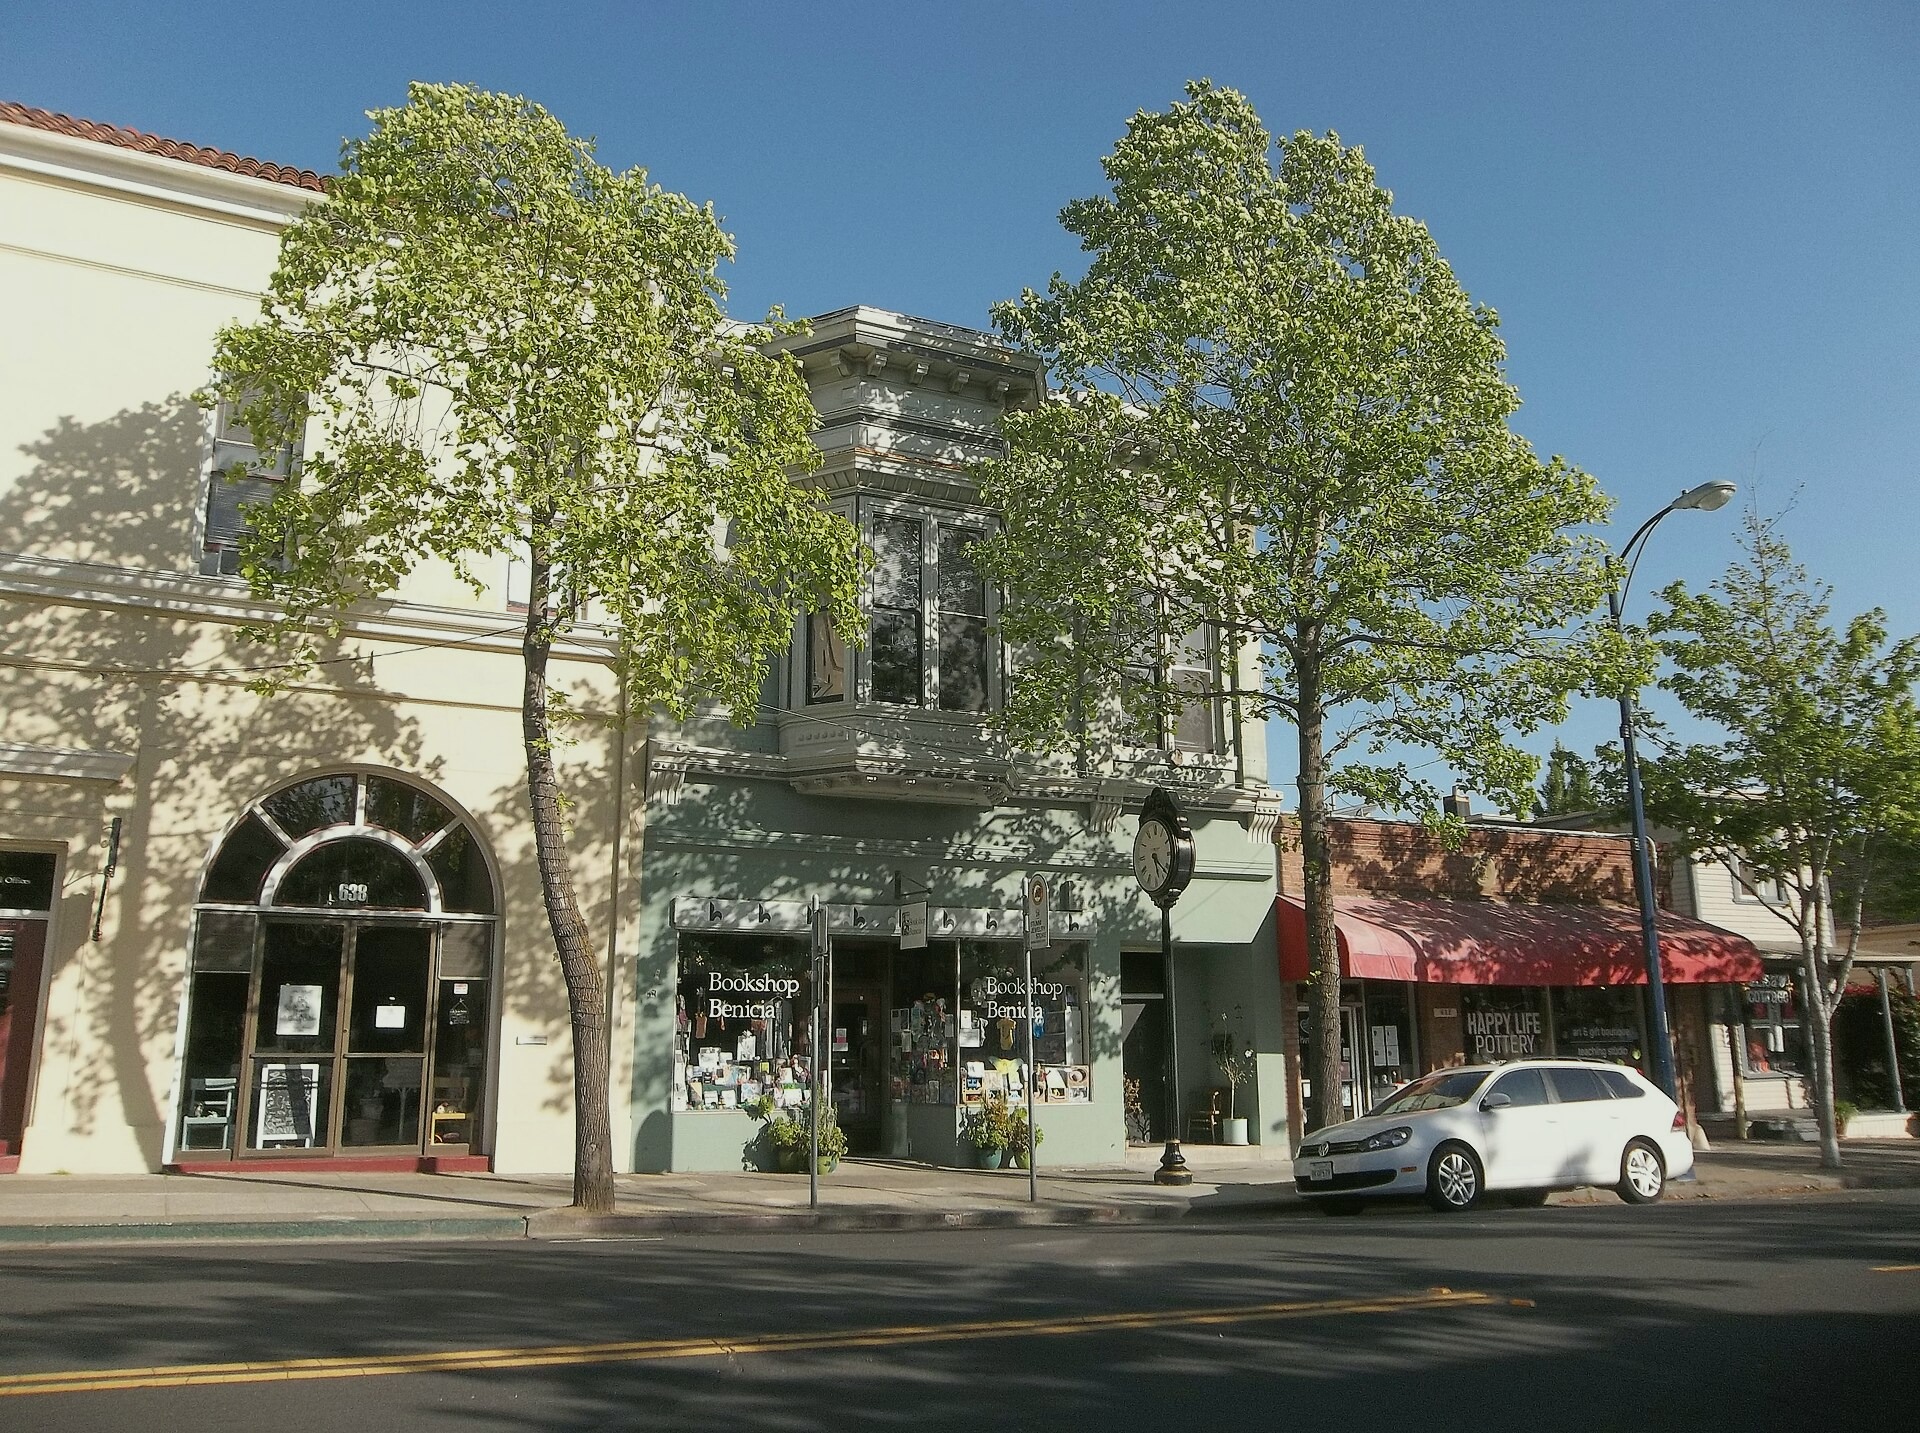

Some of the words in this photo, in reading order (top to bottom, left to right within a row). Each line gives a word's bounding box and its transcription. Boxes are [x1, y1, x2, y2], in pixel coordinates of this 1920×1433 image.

[339, 883, 368, 902] 638
[708, 972, 800, 998] Bookshop
[986, 976, 1063, 1001] Bookshop
[708, 998, 776, 1019] Benicia
[987, 1001, 1043, 1019] Benicia
[1467, 1011, 1511, 1034] HAPPY
[1514, 1012, 1541, 1034] LIFE
[1475, 1034, 1535, 1054] POTTERY
